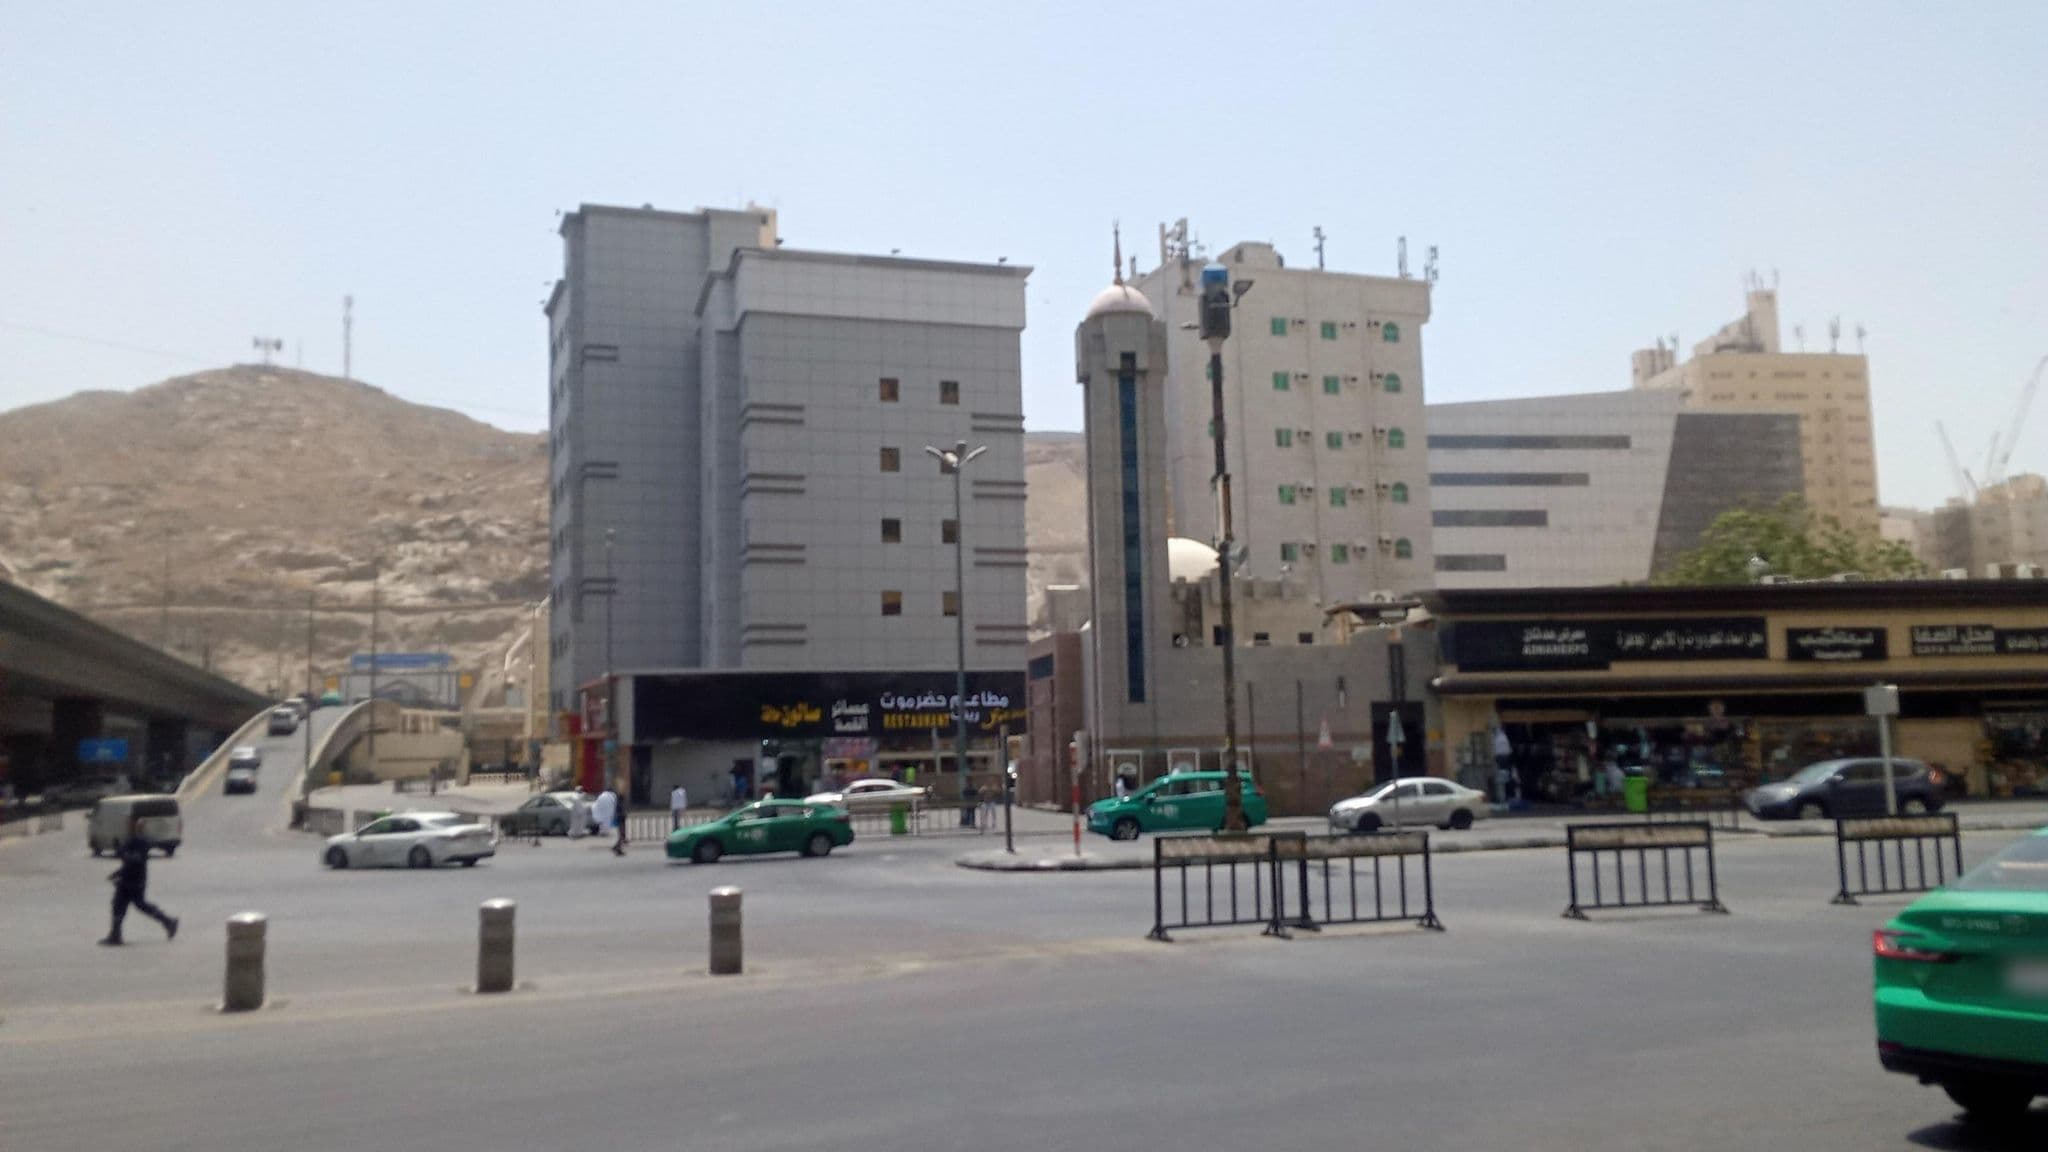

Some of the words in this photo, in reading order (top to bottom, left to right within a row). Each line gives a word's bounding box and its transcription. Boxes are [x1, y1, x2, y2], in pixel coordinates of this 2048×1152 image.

[880, 690, 947, 711] حضرموت
[950, 691, 1009, 711] مطاعم
[883, 713, 950, 729] RESTAURANT
